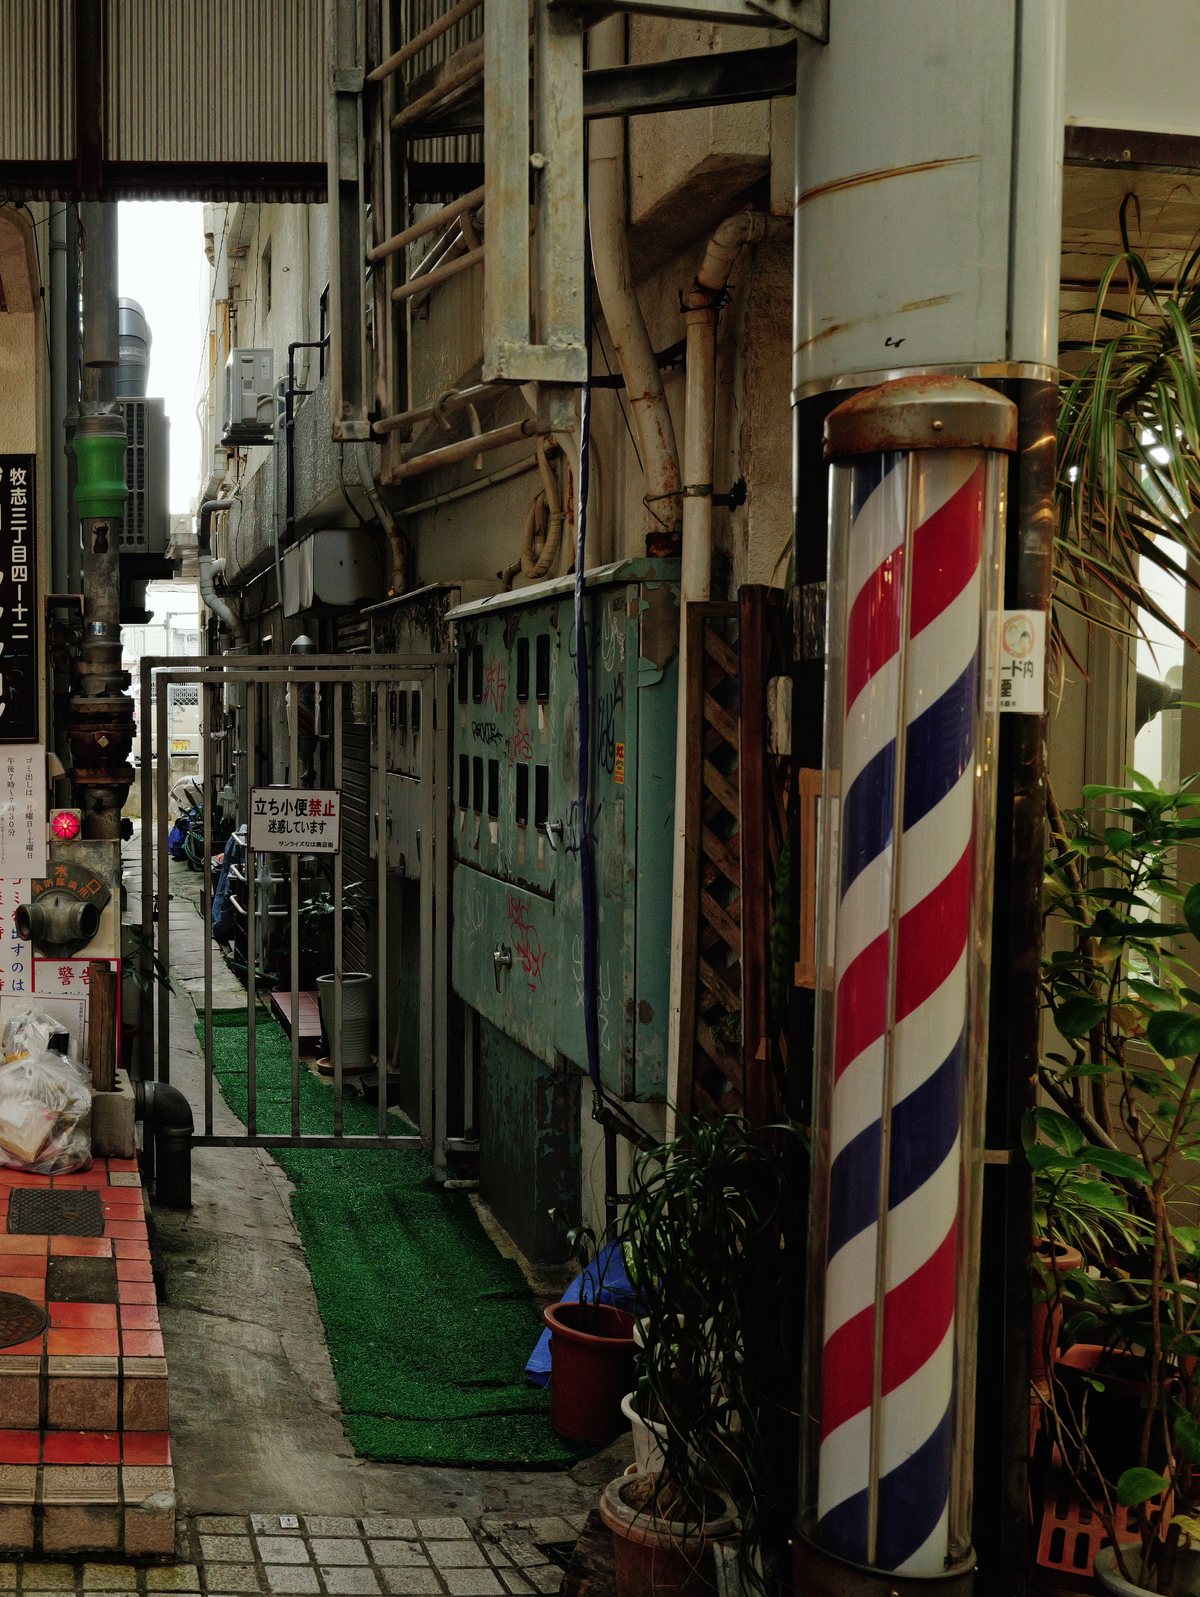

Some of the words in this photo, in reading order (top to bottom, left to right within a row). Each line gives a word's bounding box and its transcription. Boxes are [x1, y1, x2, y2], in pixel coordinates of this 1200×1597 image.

[25, 757, 33, 796] ゴミ出しは
[254, 797, 336, 817] 立ち小便禁止
[268, 819, 327, 834] 迷惑しています
[278, 840, 334, 848] サンライズなは商店街
